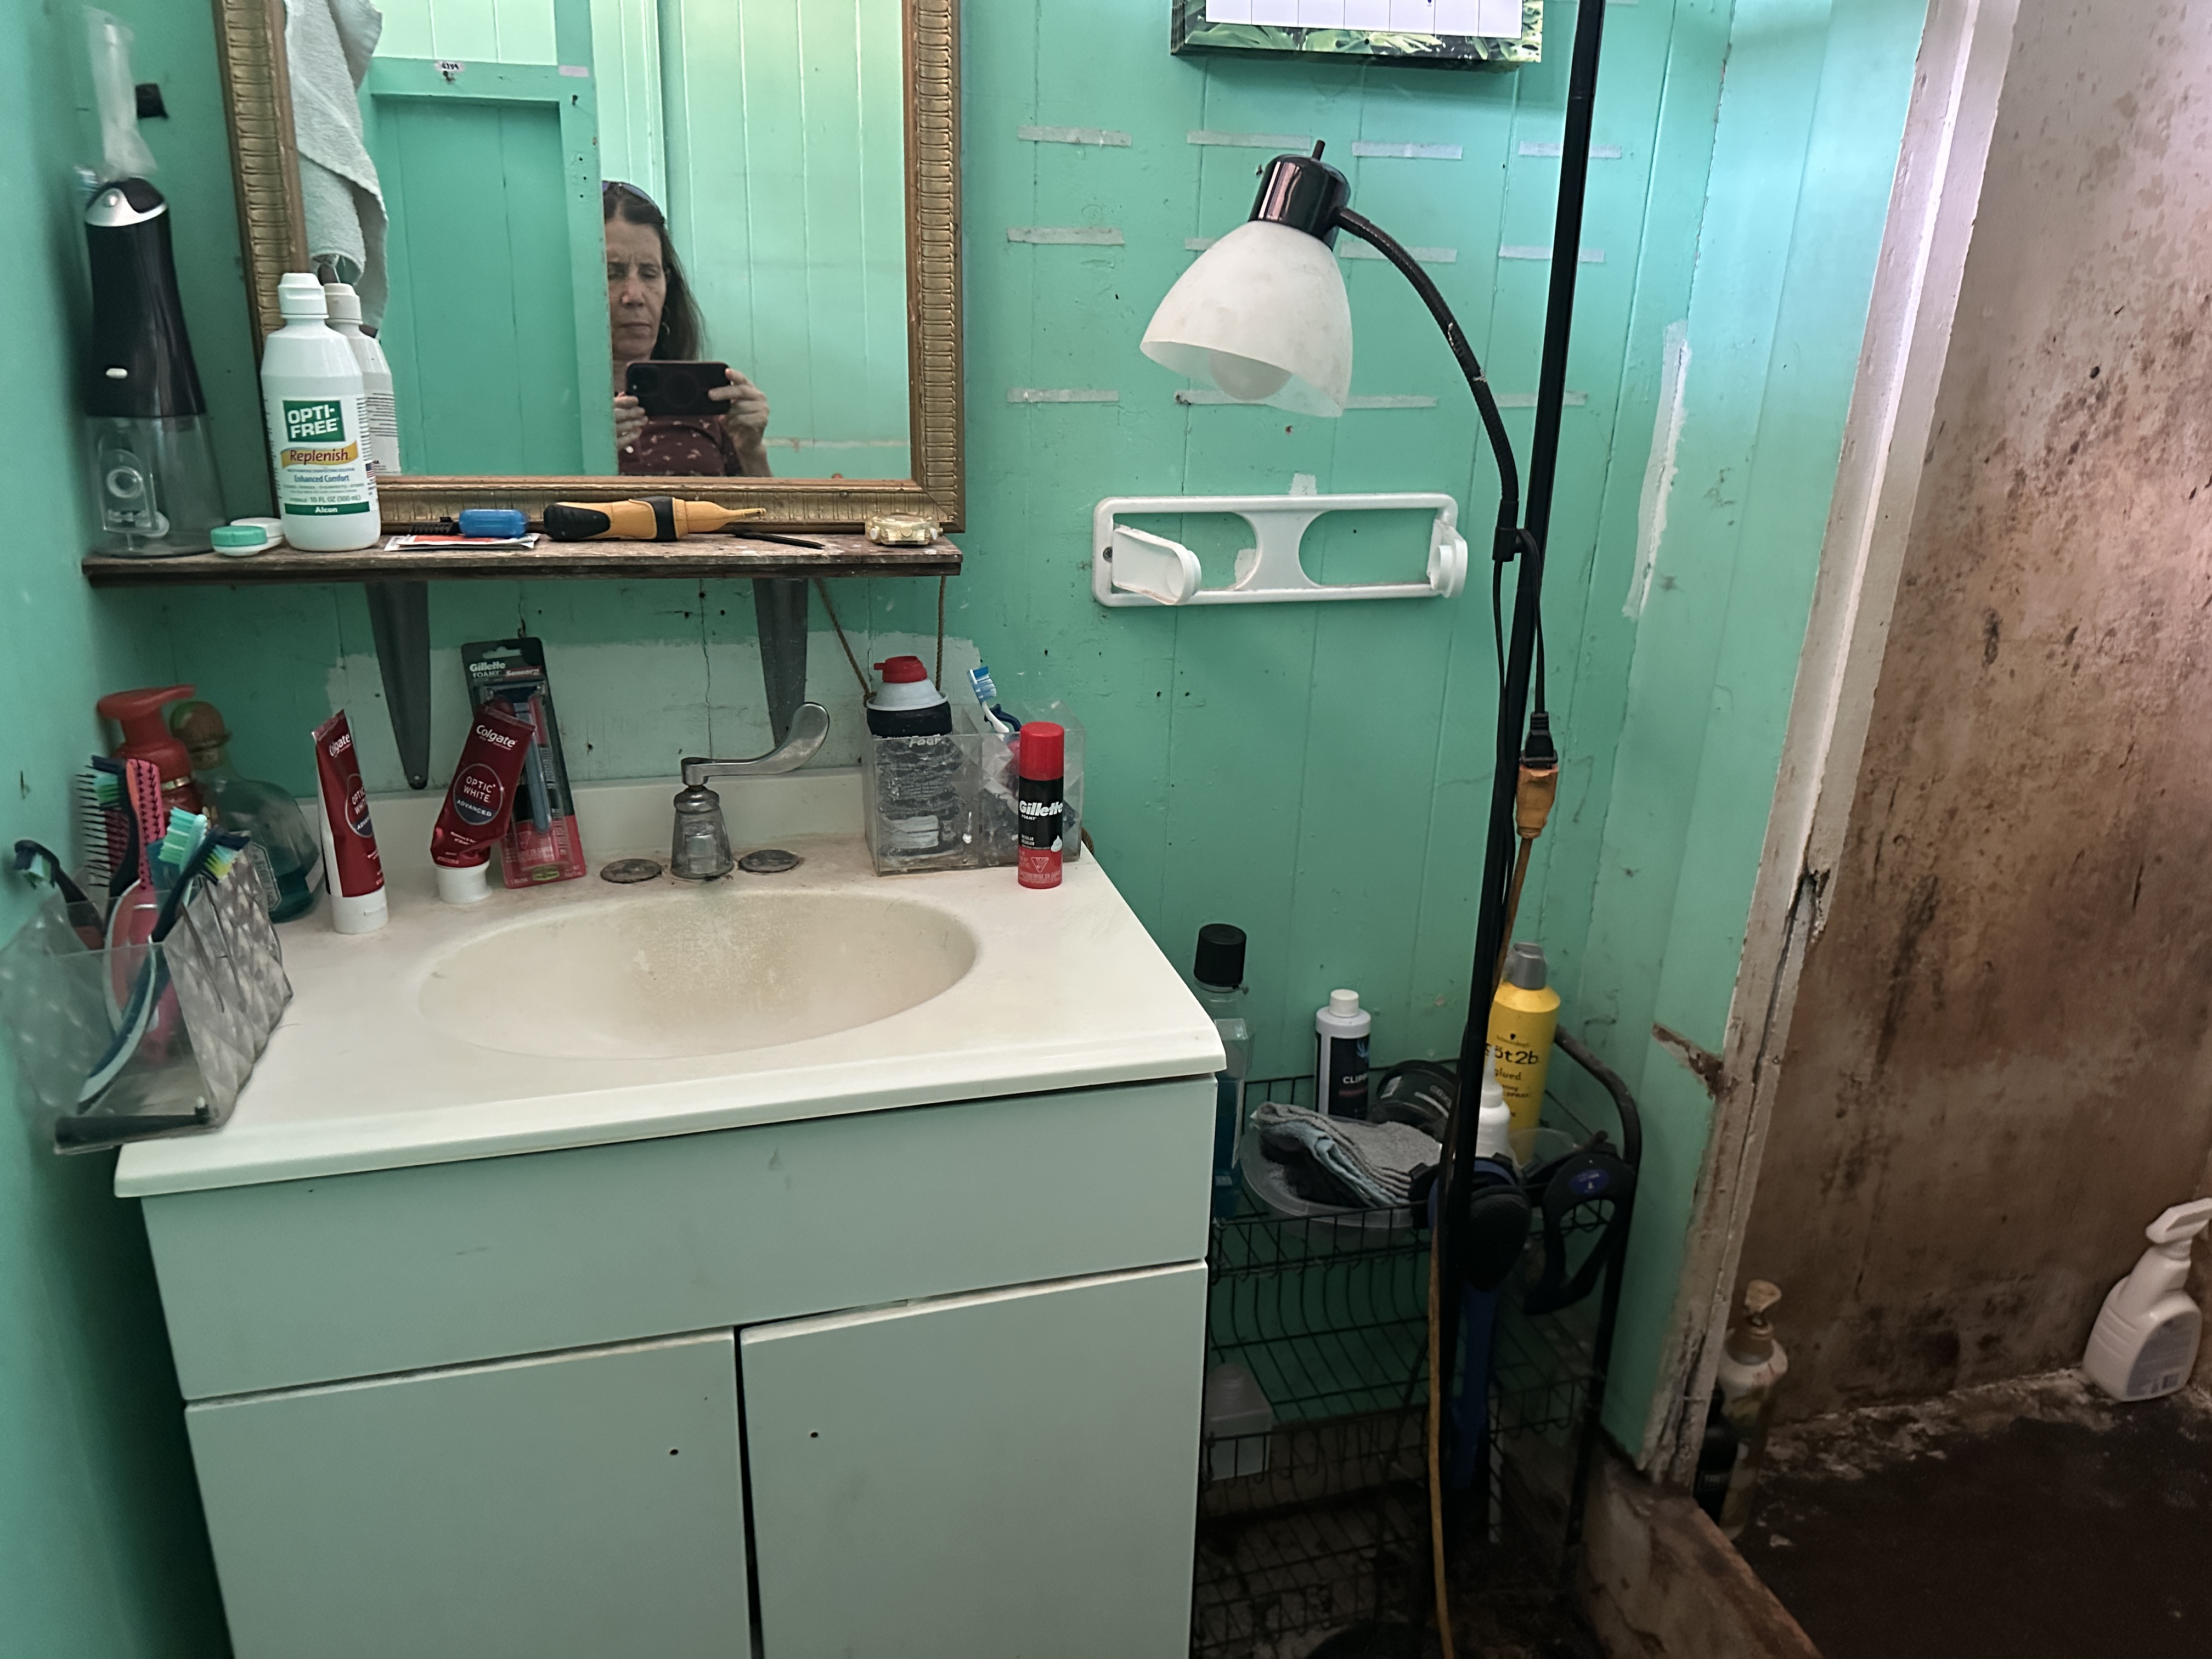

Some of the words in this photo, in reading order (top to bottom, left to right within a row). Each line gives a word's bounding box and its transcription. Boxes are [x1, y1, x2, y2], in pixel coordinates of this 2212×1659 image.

[287, 404, 335, 424] OPTI-
[290, 417, 338, 438] FREE
[290, 449, 348, 465] Replenish
[325, 474, 349, 482] Comfort
[470, 661, 506, 672] Gillette
[476, 725, 516, 748] Colgate
[466, 776, 493, 793] OPTIC
[464, 785, 490, 803] WHITE
[457, 799, 492, 817] ADVANCED
[1019, 800, 1063, 816] Gillette
